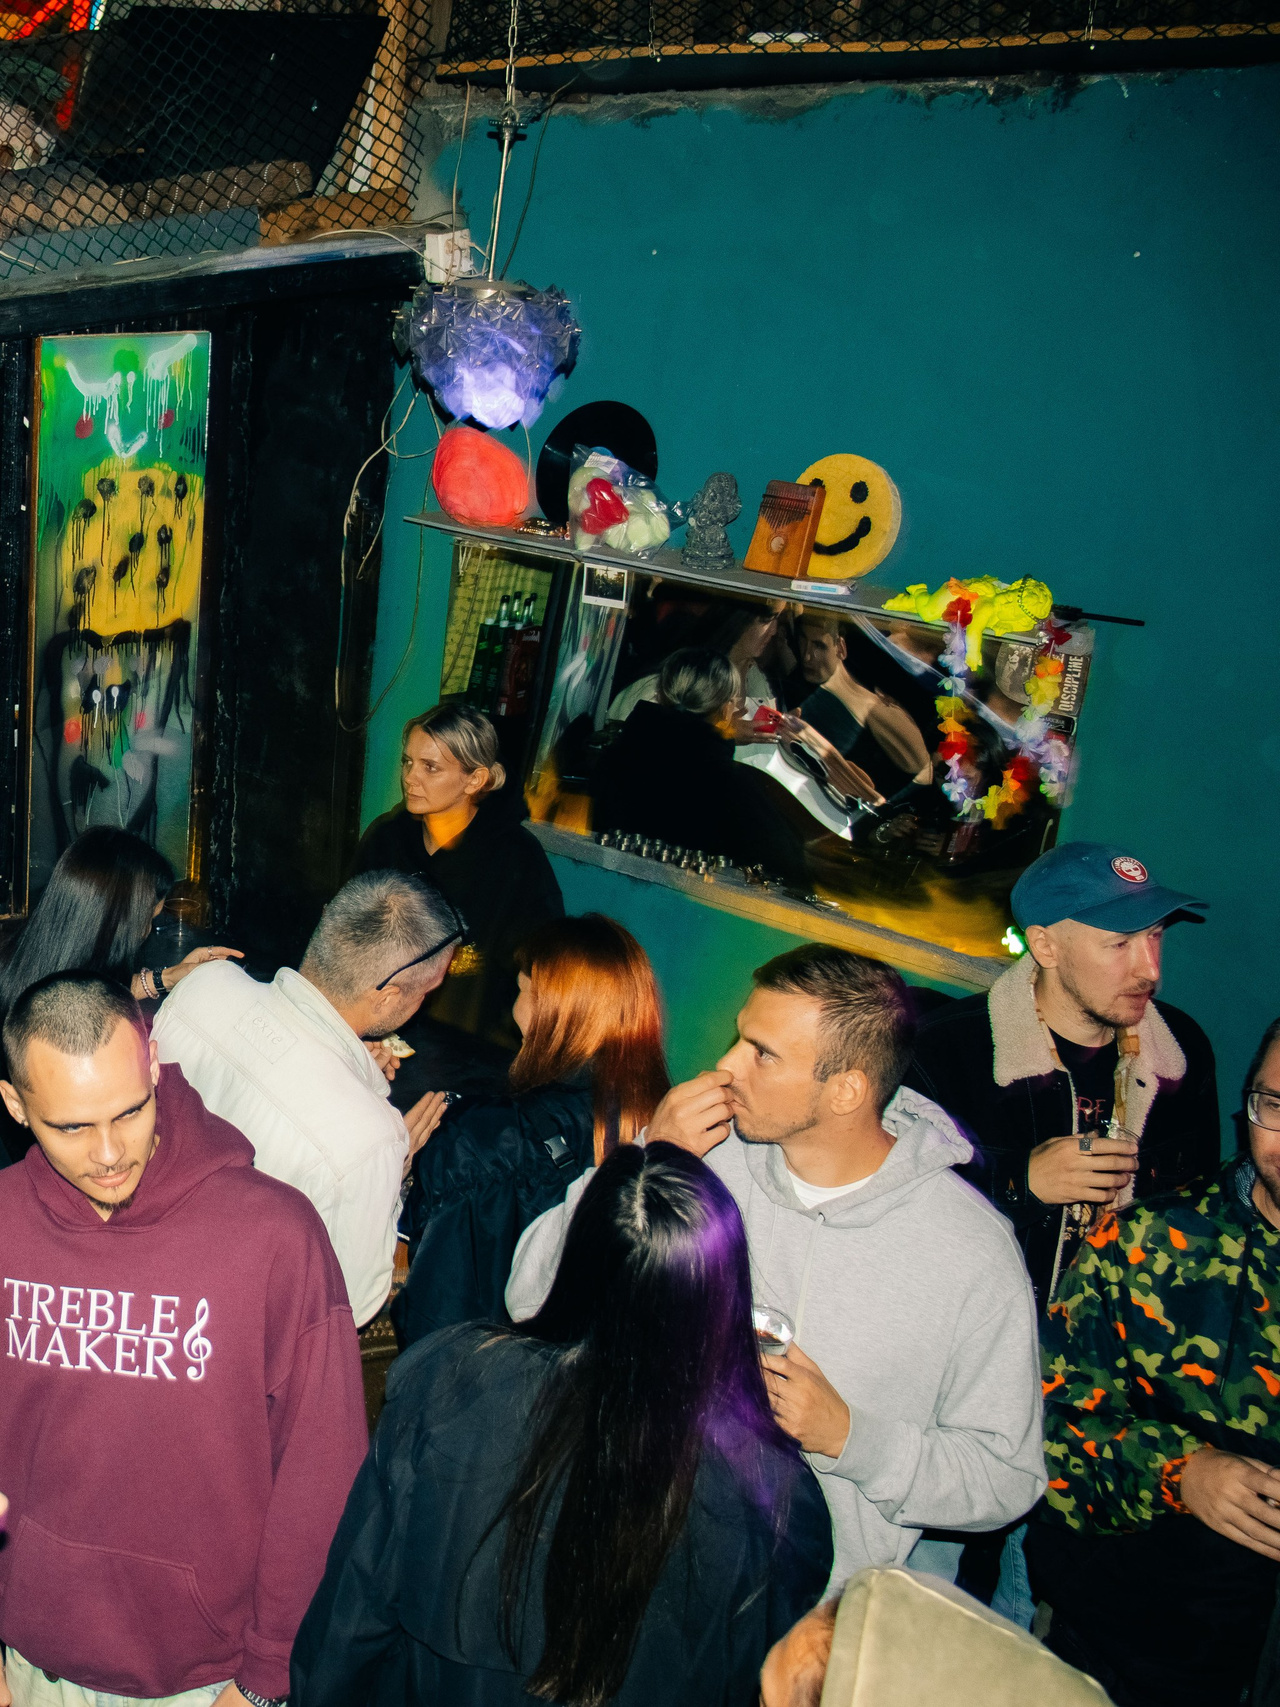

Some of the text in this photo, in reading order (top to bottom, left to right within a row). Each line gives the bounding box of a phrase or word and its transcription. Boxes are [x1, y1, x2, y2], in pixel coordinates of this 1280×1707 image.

[1058, 654, 1083, 711] DISCIPLINE
[4, 1277, 179, 1338] TREBLE
[5, 1317, 177, 1380] MAKER
